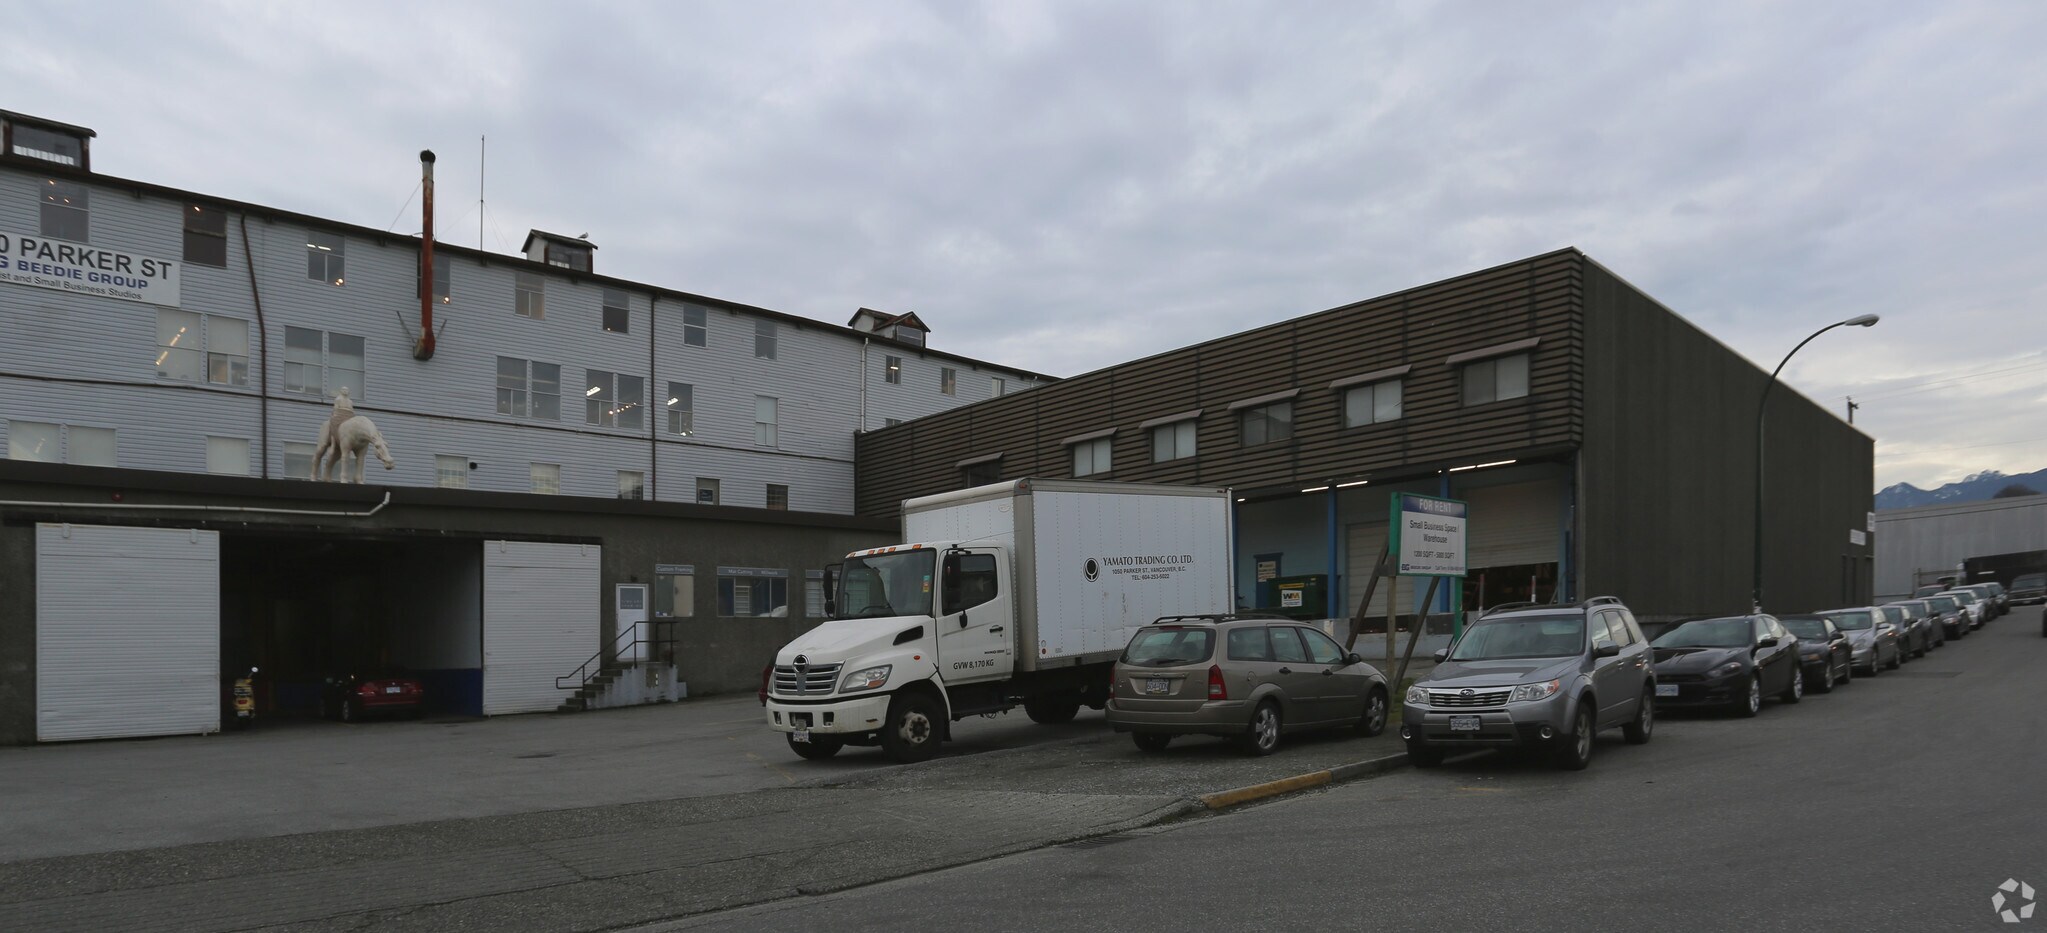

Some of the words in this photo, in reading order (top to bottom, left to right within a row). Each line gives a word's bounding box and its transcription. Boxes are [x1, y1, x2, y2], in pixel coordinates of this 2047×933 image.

[20, 237, 132, 275] PARKER
[140, 258, 173, 280] ST
[18, 260, 83, 279] BEEDIE
[88, 272, 148, 290] GROUP
[13, 274, 32, 284] and
[34, 276, 61, 288] Small
[64, 280, 106, 295] Business
[108, 287, 142, 300] Studios
[1419, 498, 1433, 510] FOR
[1434, 500, 1452, 512] RENT
[1410, 520, 1423, 529] Small
[1423, 521, 1444, 532] Business
[1444, 523, 1457, 533] Space
[1423, 533, 1448, 543] Warehouse
[1102, 556, 1133, 566] YAMATO
[1134, 555, 1165, 566] TRADING
[1167, 555, 1179, 565] CO.
[1180, 554, 1194, 564] LTD.
[1123, 567, 1142, 575] PARKER
[953, 661, 968, 670] GVW
[969, 659, 985, 669] 8,170
[985, 658, 994, 667] KG
